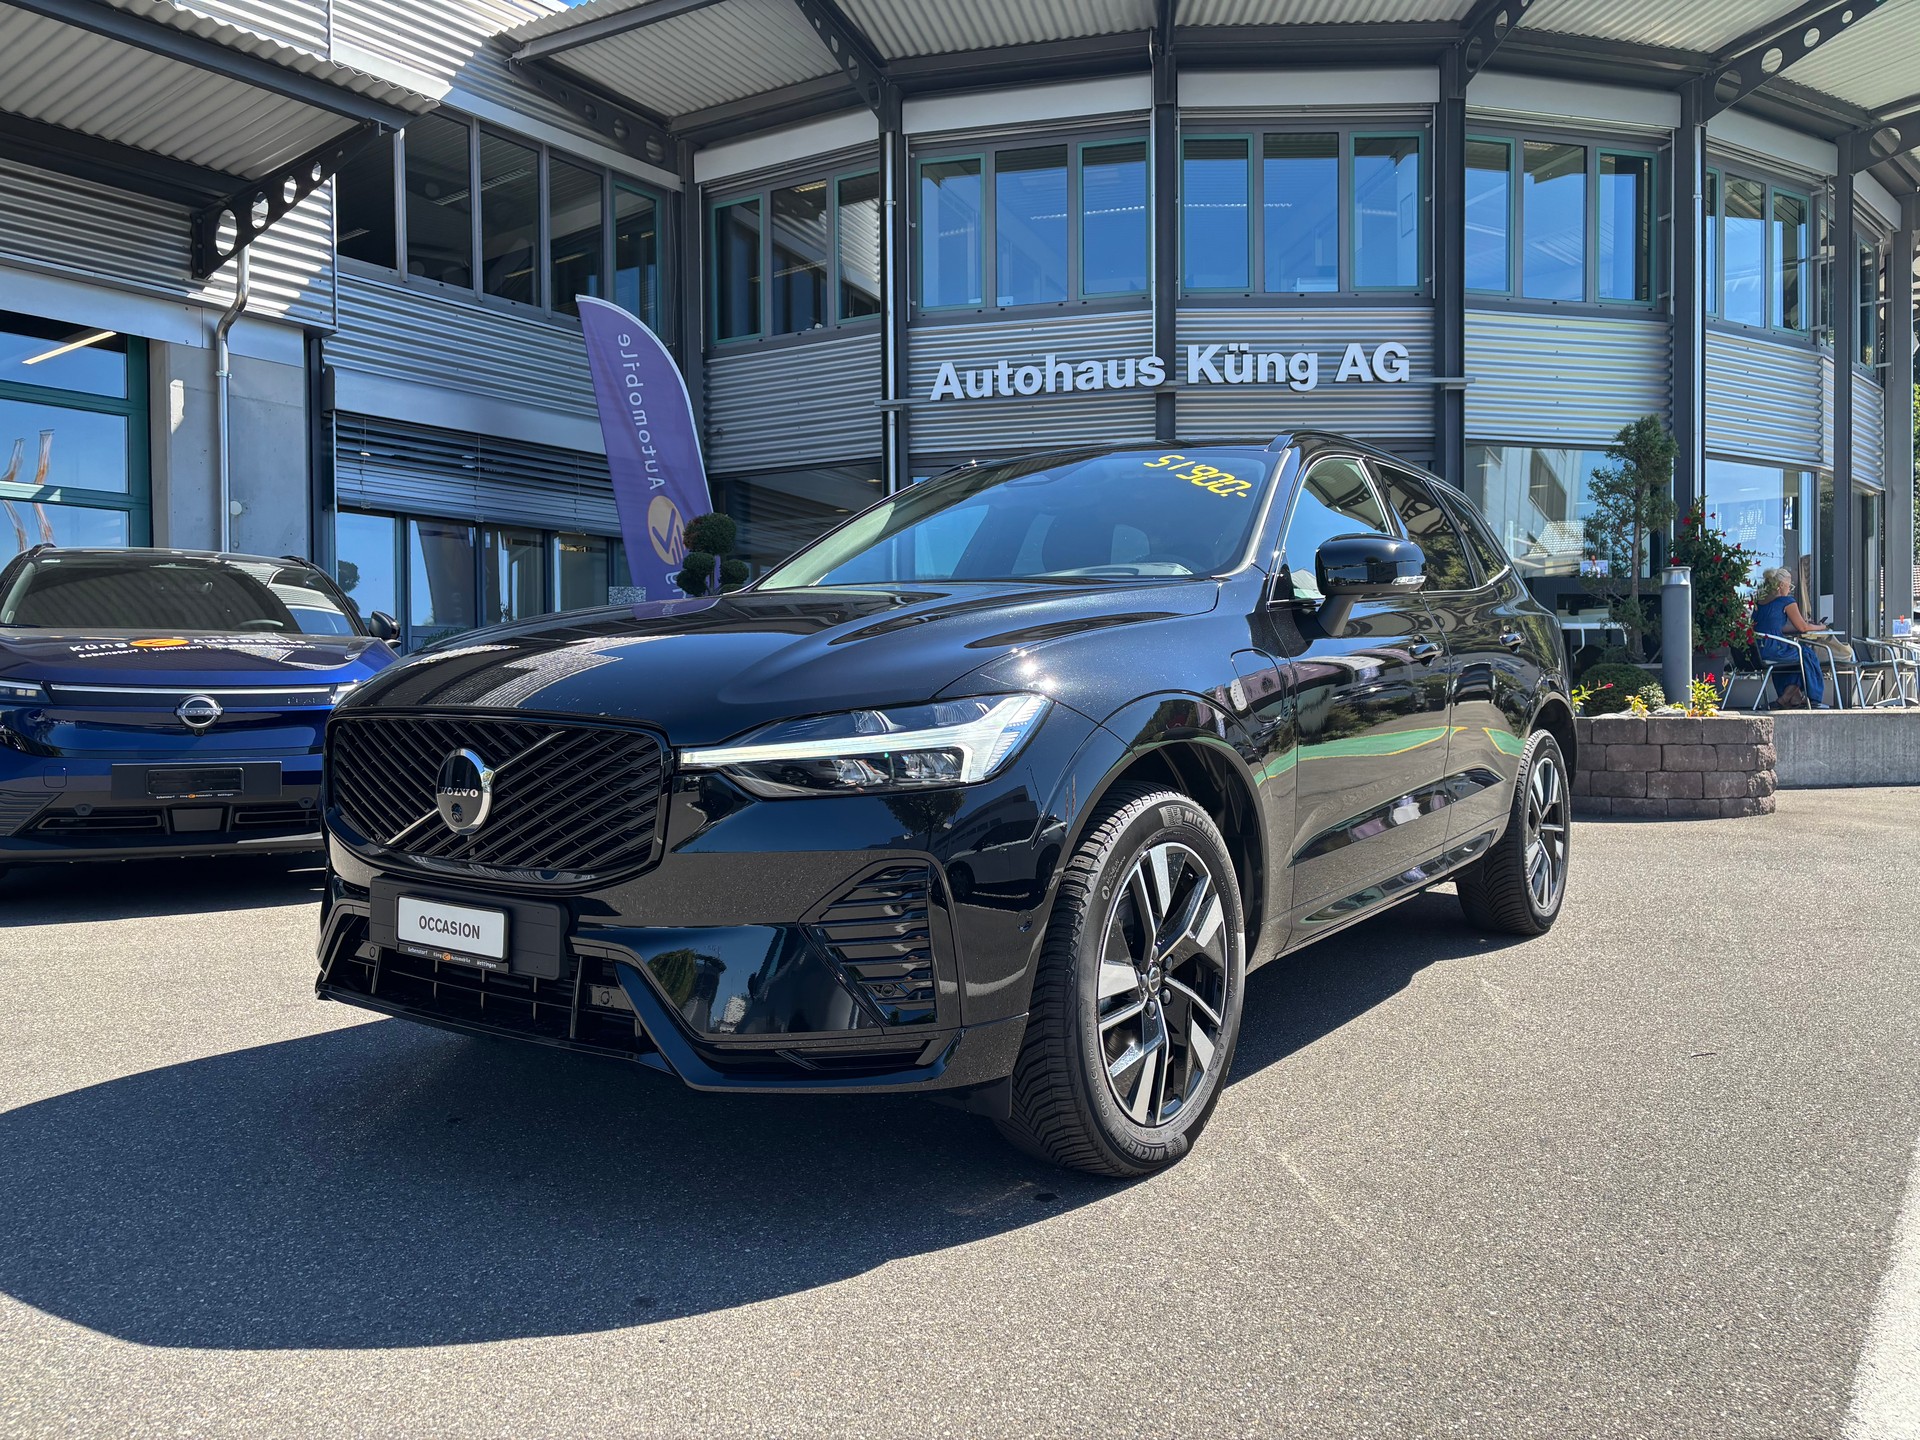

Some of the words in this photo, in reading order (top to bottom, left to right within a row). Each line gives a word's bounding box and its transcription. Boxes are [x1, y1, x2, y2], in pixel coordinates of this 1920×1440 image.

[930, 354, 1166, 400] Autohaus
[1186, 344, 1318, 391] Küng
[1336, 342, 1410, 383] AG
[176, 707, 221, 716] NISSAN
[440, 786, 479, 798] VOLVO
[1183, 810, 1227, 856] MICHELIN
[419, 915, 480, 940] OCCASION
[1108, 1122, 1165, 1161] MICHELIN
